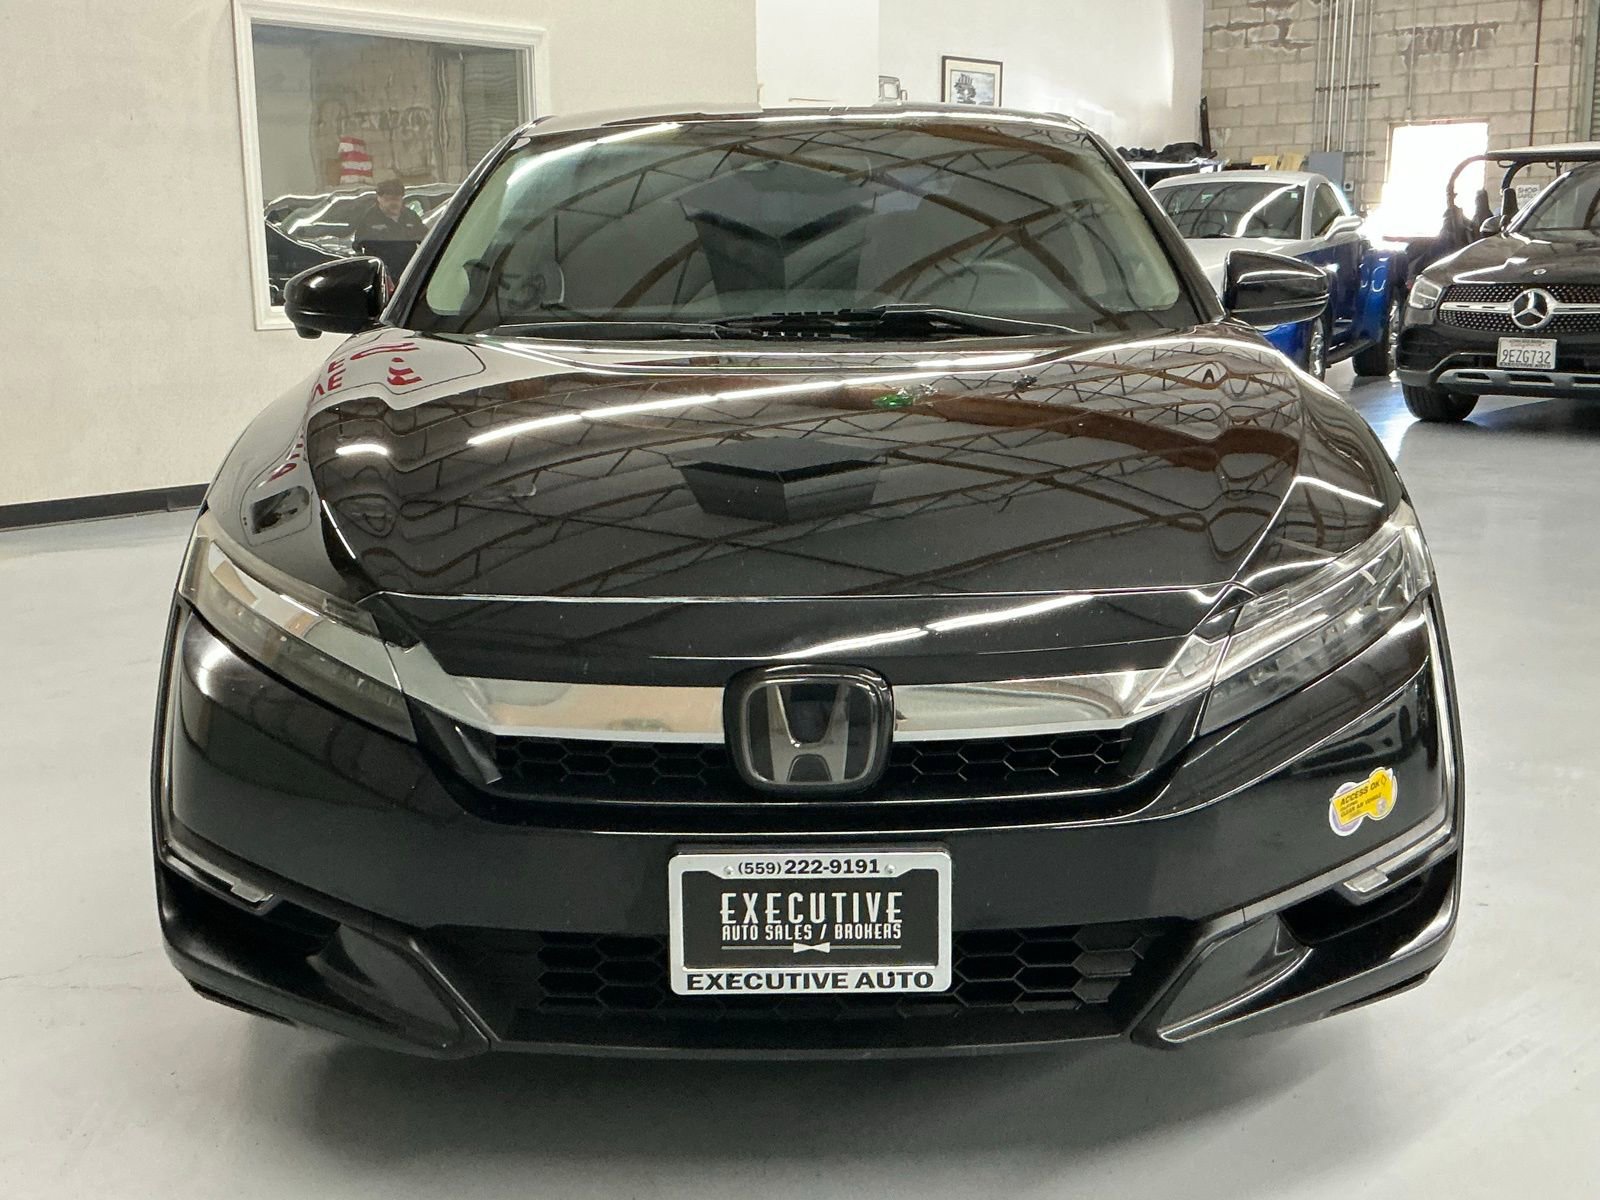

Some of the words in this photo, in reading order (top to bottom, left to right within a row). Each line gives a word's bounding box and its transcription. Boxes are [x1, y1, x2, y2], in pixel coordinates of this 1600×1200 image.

[1502, 349, 1551, 364] 9EZG732
[1340, 786, 1369, 805] ACCESS
[738, 861, 782, 876] (559)
[784, 858, 880, 875] 222-9191
[720, 891, 903, 925] EXECUTIVE
[722, 924, 759, 941] AUTO
[765, 923, 813, 941] SALES
[834, 923, 902, 940] BROKERS
[687, 971, 848, 991] EXECUTIVE
[854, 970, 934, 990] AUTO
